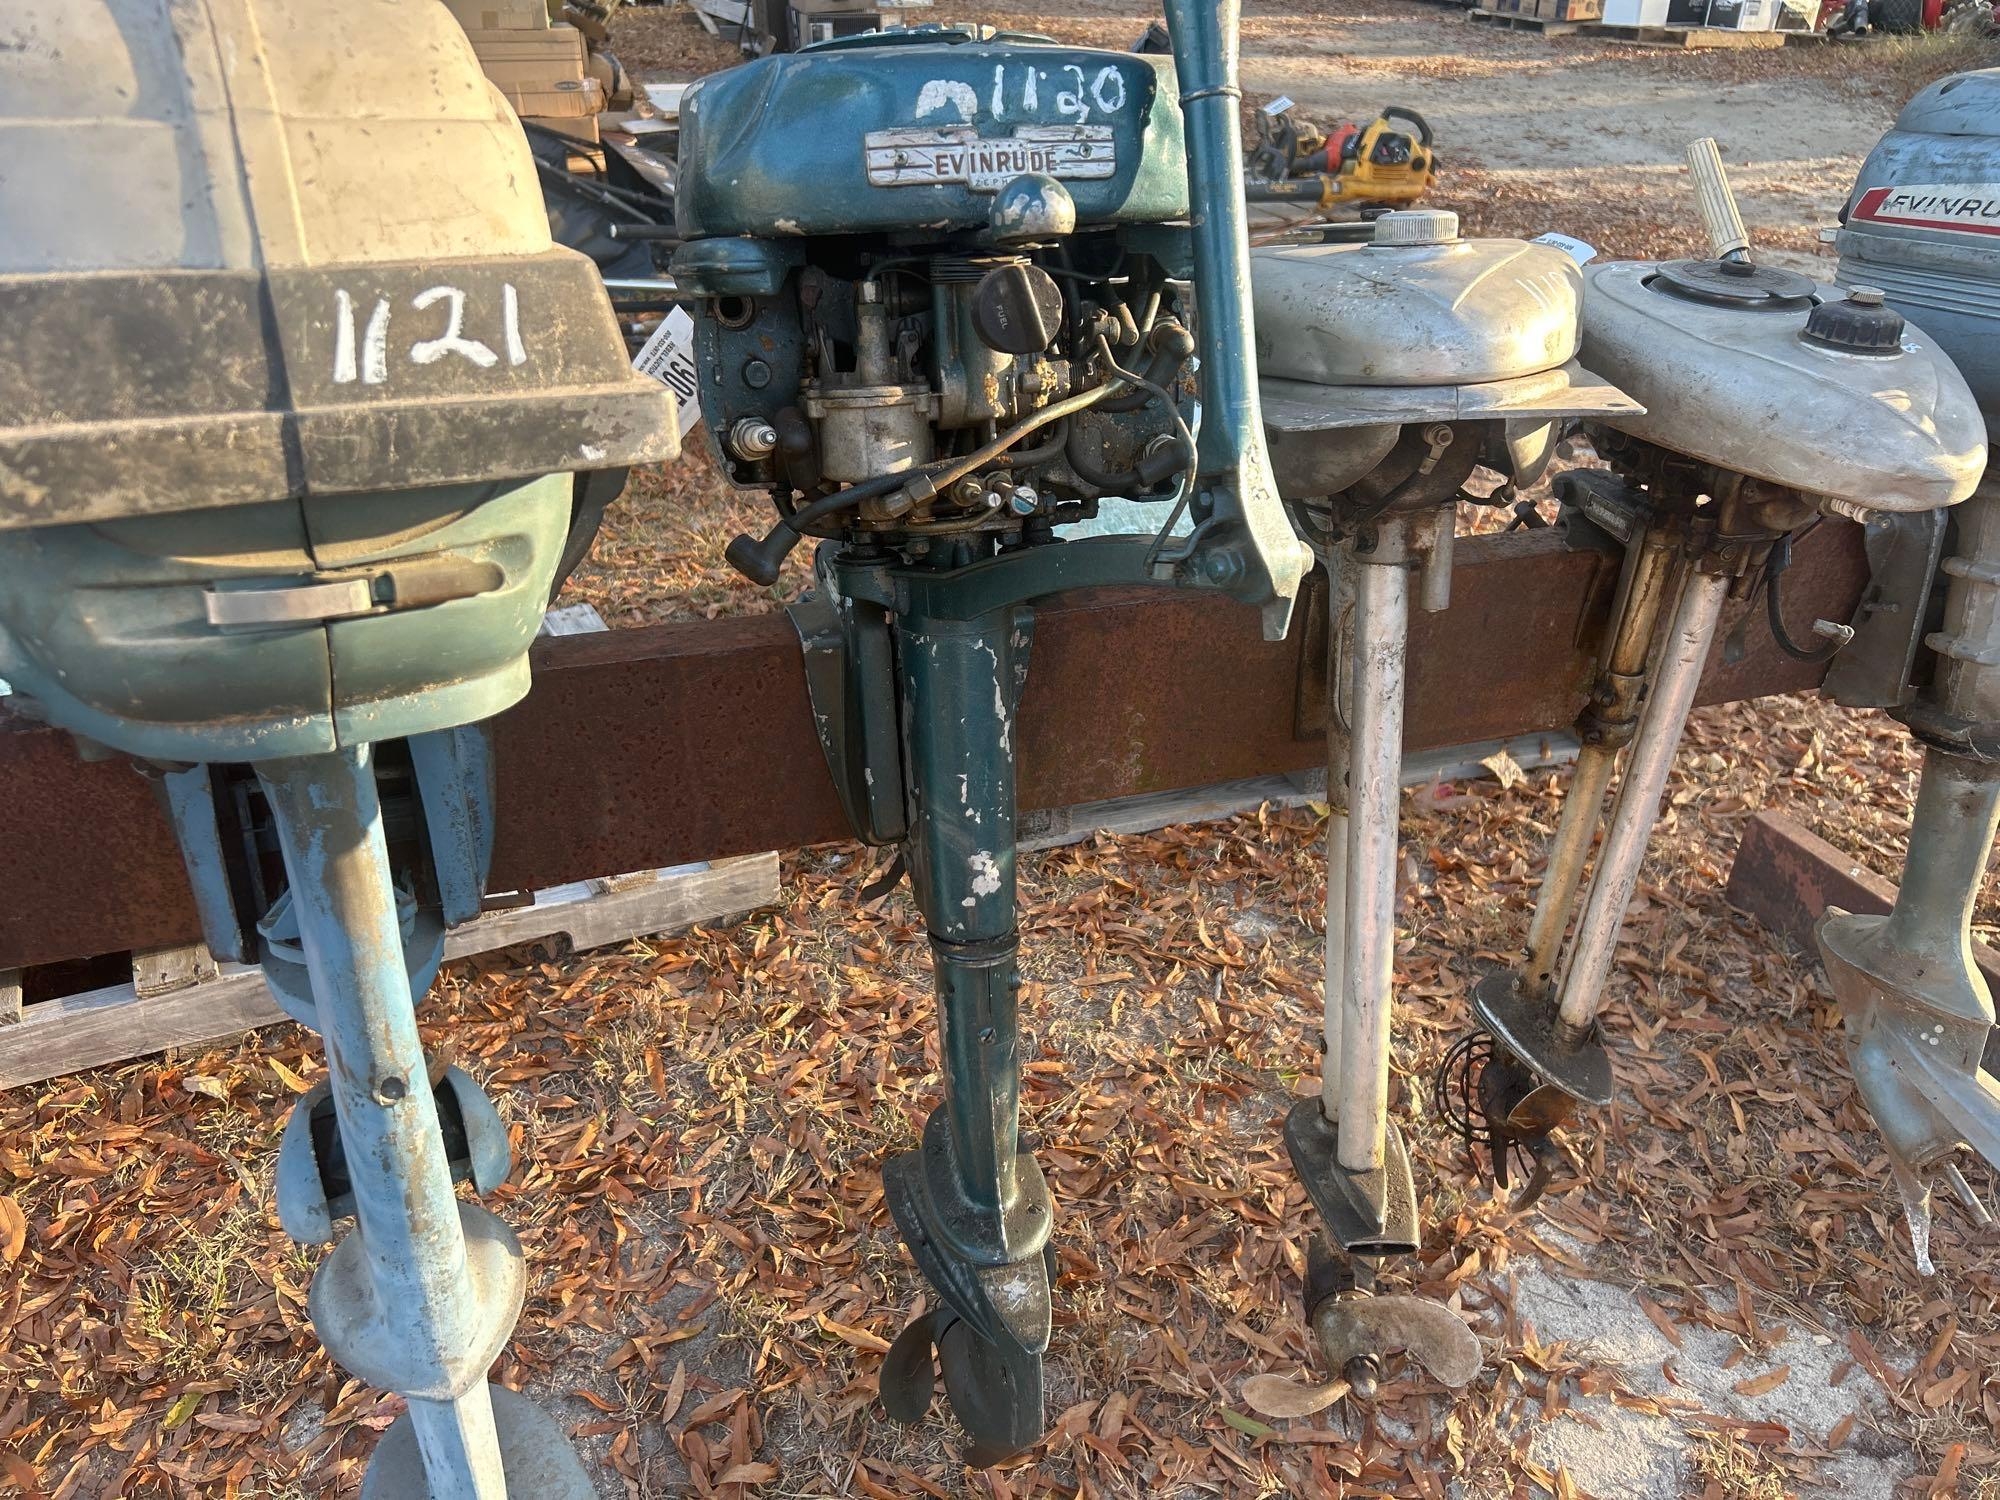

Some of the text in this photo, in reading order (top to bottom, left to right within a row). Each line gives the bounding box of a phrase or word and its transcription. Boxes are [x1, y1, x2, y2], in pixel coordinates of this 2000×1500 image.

[935, 150, 1058, 176] EVINRUDE
[976, 178, 1008, 187] ZEPH
[1883, 195, 2000, 219] EVINRU
[996, 305, 1008, 331] FUEL
[334, 283, 527, 384] 1121
